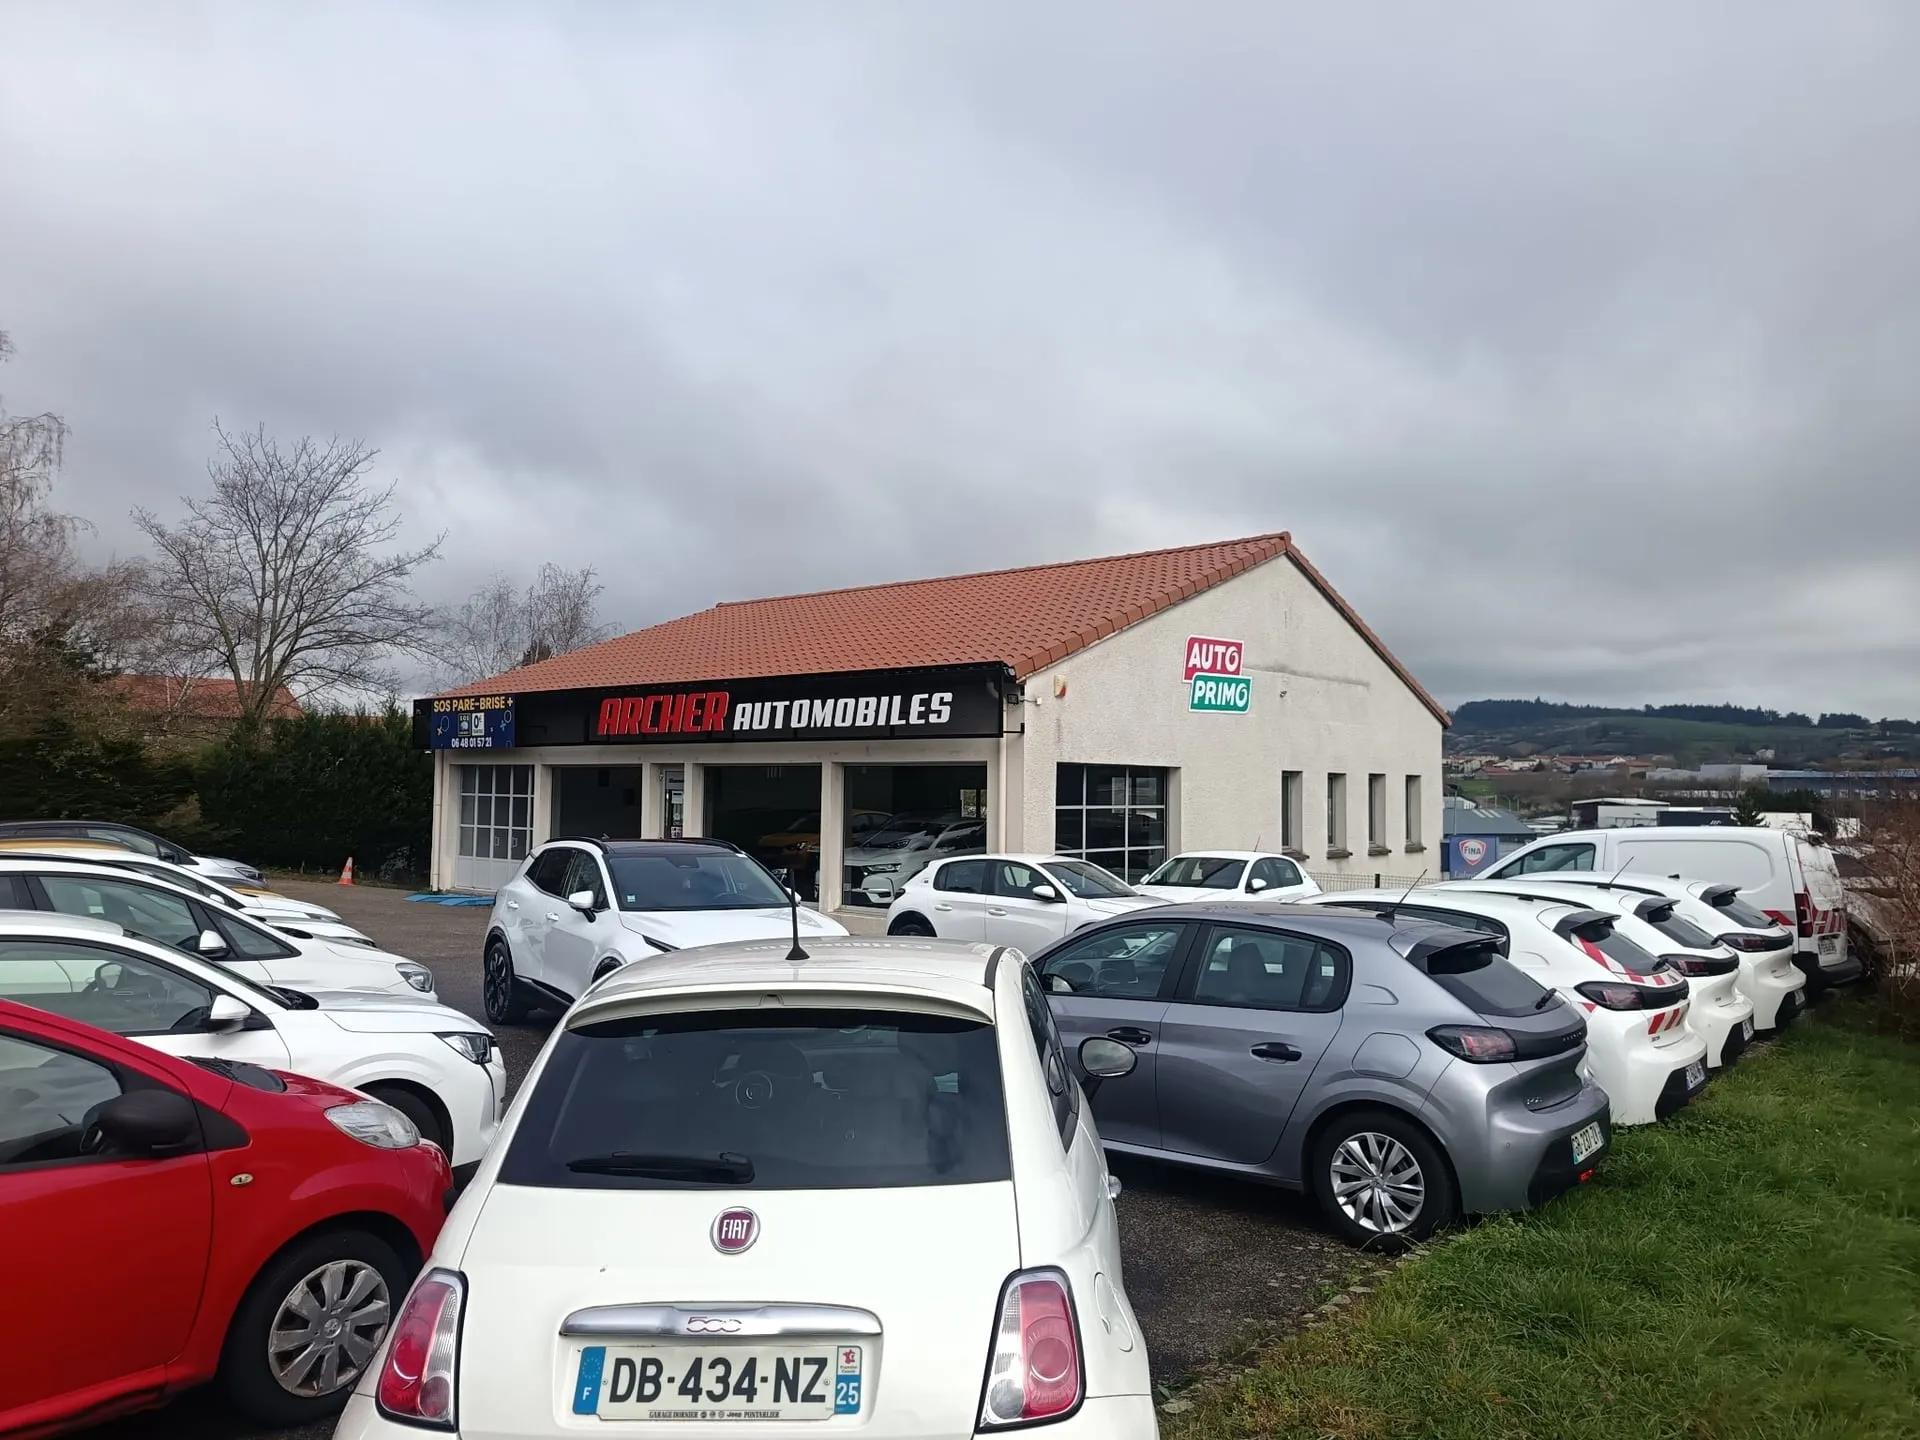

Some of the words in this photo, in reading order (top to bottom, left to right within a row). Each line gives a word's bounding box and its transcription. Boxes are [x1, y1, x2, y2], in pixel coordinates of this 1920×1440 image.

[1188, 643, 1239, 672] AUTO
[433, 700, 451, 712] SOS
[452, 696, 506, 712] PARE-BRISE
[1193, 680, 1248, 707] PRIMO
[597, 691, 729, 735] ARCHER
[732, 692, 953, 731] AUTOMOBILES
[451, 737, 459, 748] 06
[460, 737, 469, 748] 48
[470, 737, 476, 748] 01
[477, 736, 485, 747] 57
[485, 736, 492, 747] 21
[1464, 847, 1481, 855] FINA
[721, 1219, 750, 1240] FIAT
[686, 1316, 742, 1333] 500
[582, 1387, 592, 1400] F
[609, 1357, 828, 1403] DB-434-NZ
[836, 1382, 859, 1405] 25
